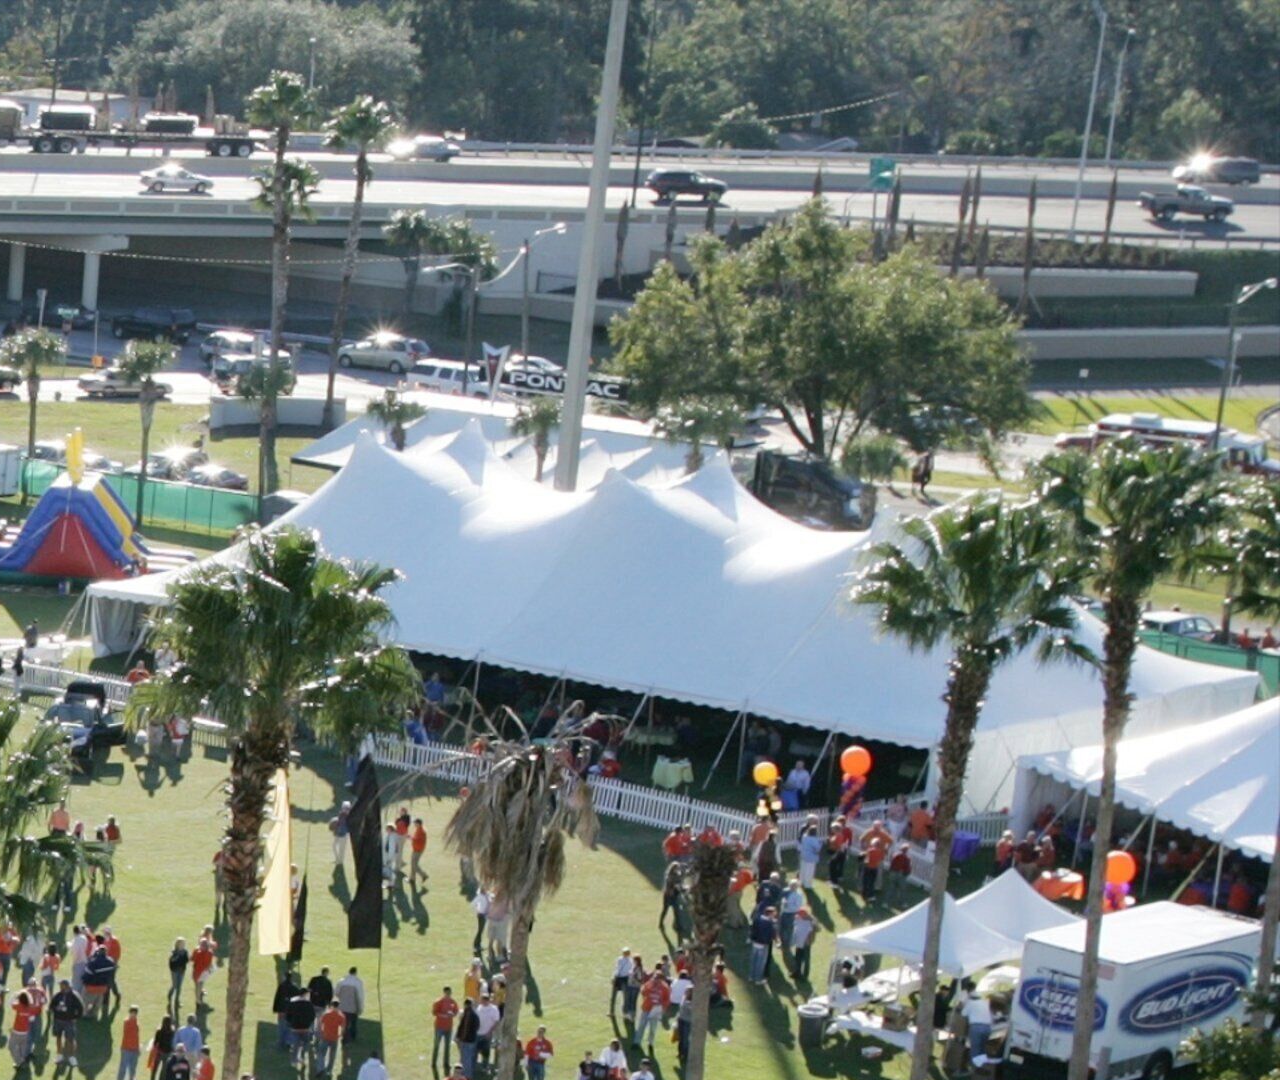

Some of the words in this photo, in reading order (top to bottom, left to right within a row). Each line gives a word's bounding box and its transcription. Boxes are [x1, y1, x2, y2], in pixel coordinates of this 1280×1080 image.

[510, 372, 620, 398] PONAC
[1136, 996, 1177, 1020] BUD
[1177, 982, 1233, 1009] LIGHT
